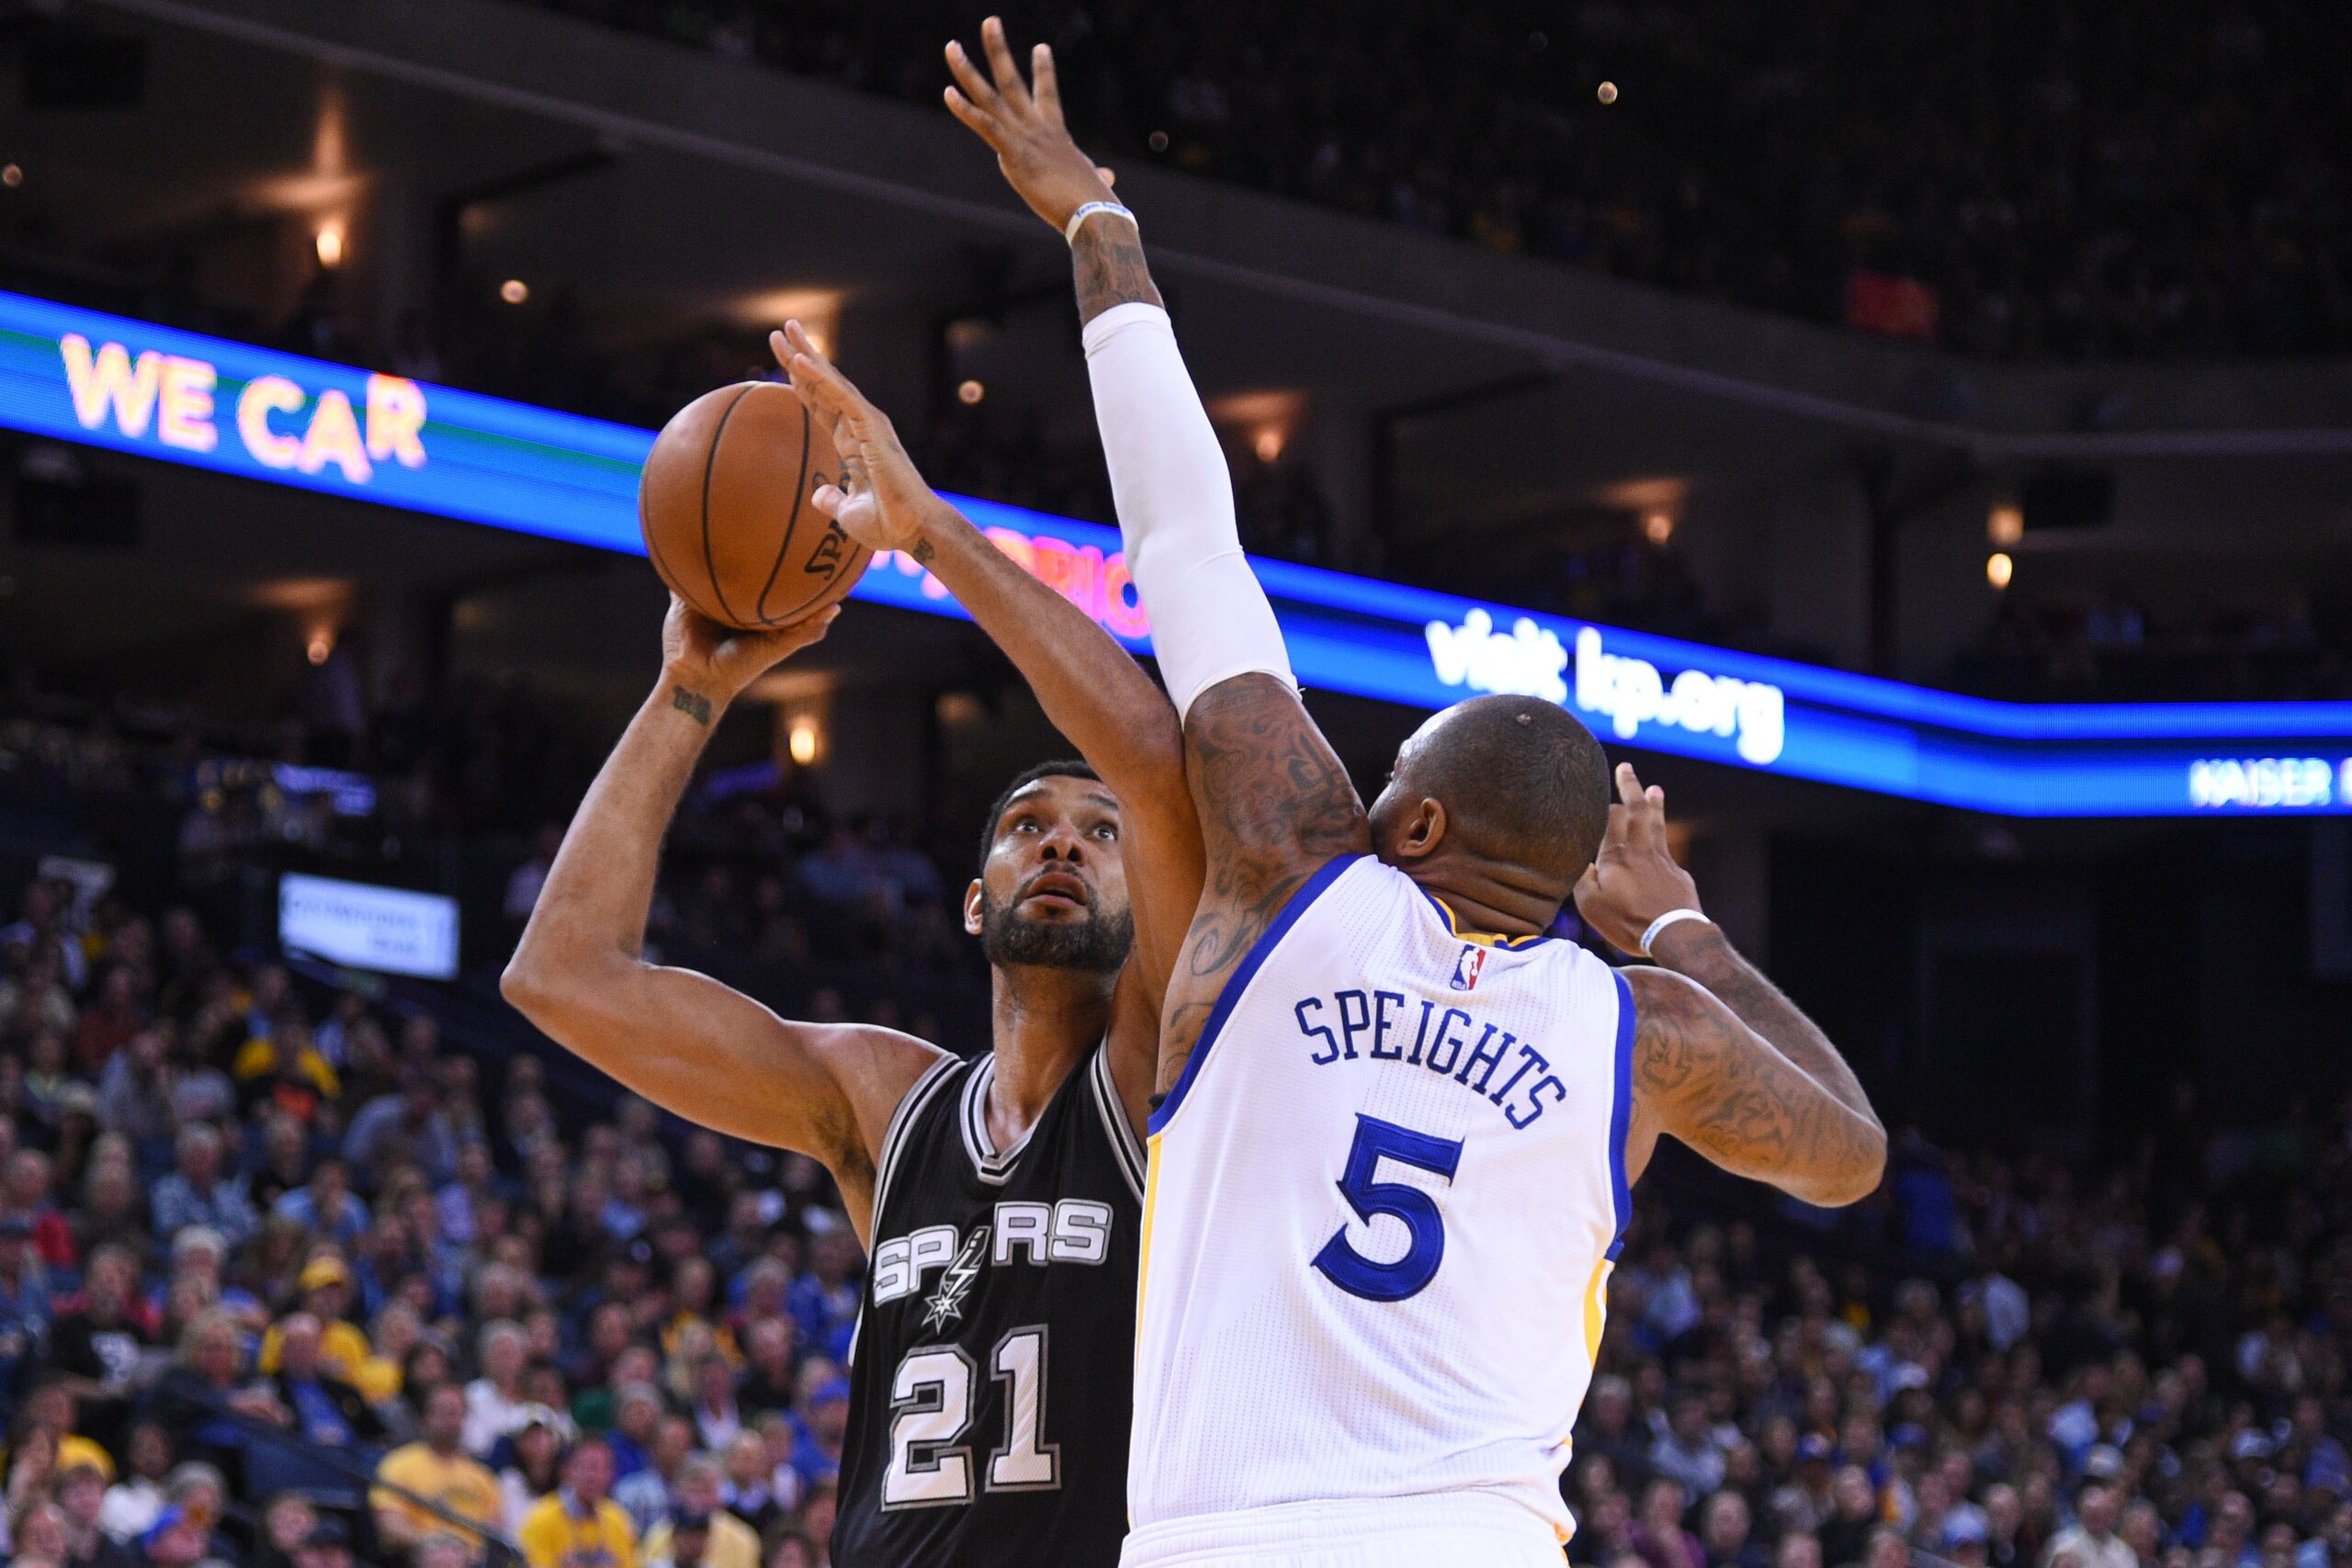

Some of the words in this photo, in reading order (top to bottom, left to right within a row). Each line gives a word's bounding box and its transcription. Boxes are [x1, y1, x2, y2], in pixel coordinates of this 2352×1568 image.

[61, 333, 219, 453] WE
[237, 371, 428, 484] CAR
[1425, 607, 1568, 704] visit
[1576, 626, 1785, 764] kp.org
[2188, 757, 2334, 807] KAISER
[1294, 988, 1566, 1130] SPEIGHTS
[1310, 1111, 1465, 1303] 5
[881, 1323, 1062, 1512] 21
